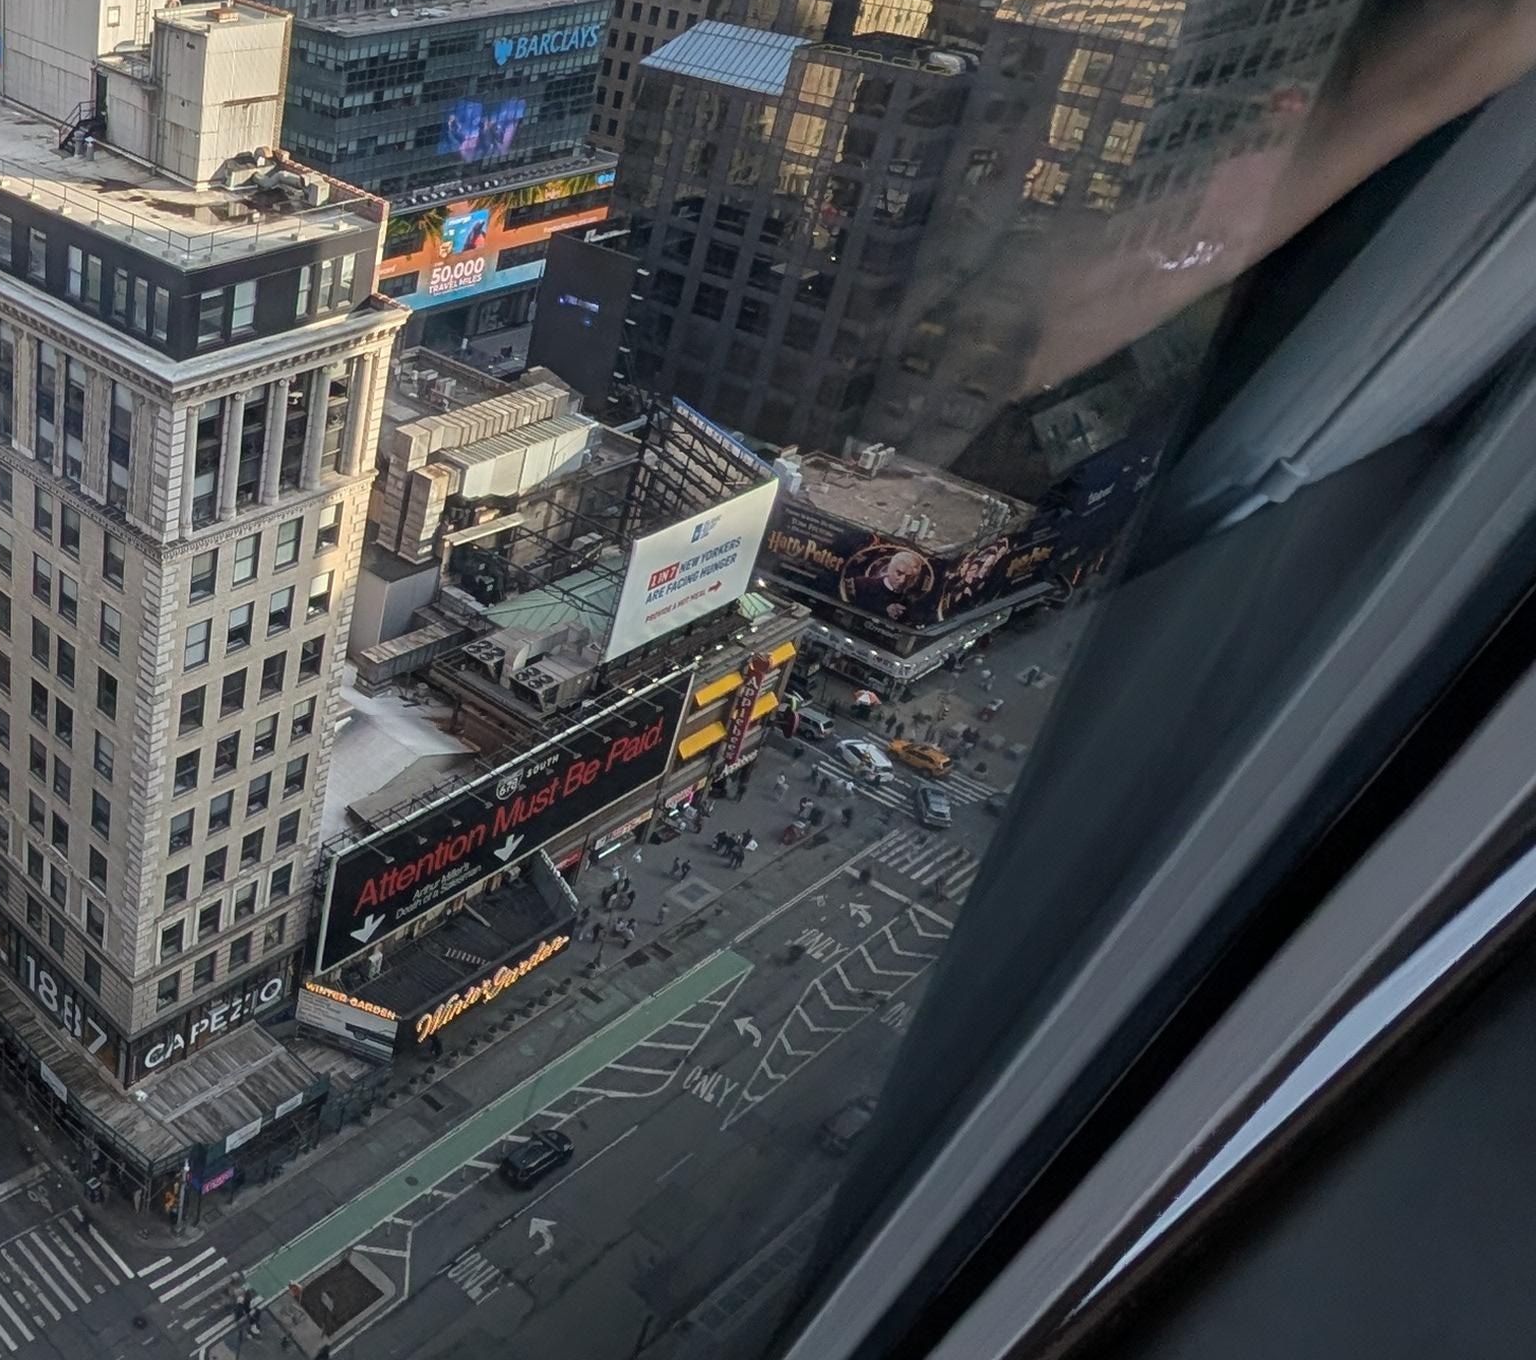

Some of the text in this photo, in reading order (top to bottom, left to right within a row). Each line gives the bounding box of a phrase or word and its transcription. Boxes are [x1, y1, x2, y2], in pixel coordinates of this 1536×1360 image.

[514, 24, 600, 60] BARCLAYS
[429, 280, 458, 294] TRAVEL
[430, 256, 485, 285] 50,000
[679, 555, 700, 573] NEW
[701, 538, 741, 562] YORKERS
[768, 530, 805, 558] Harry
[804, 539, 845, 572] Potter
[645, 552, 738, 604] ARE FACING HUNGER
[526, 754, 559, 778] SOUTH
[352, 823, 487, 917] Attention
[491, 777, 560, 842] Must
[563, 758, 602, 797] Be
[396, 899, 422, 919] Death
[26, 955, 108, 1055] 1887
[305, 981, 348, 1003] WINTER
[349, 996, 396, 1020] GARDEN
[416, 979, 493, 1043] Winter
[482, 935, 570, 1005] Garden
[144, 978, 282, 1069] CAPEZIO
[682, 1065, 739, 1108] ONLY
